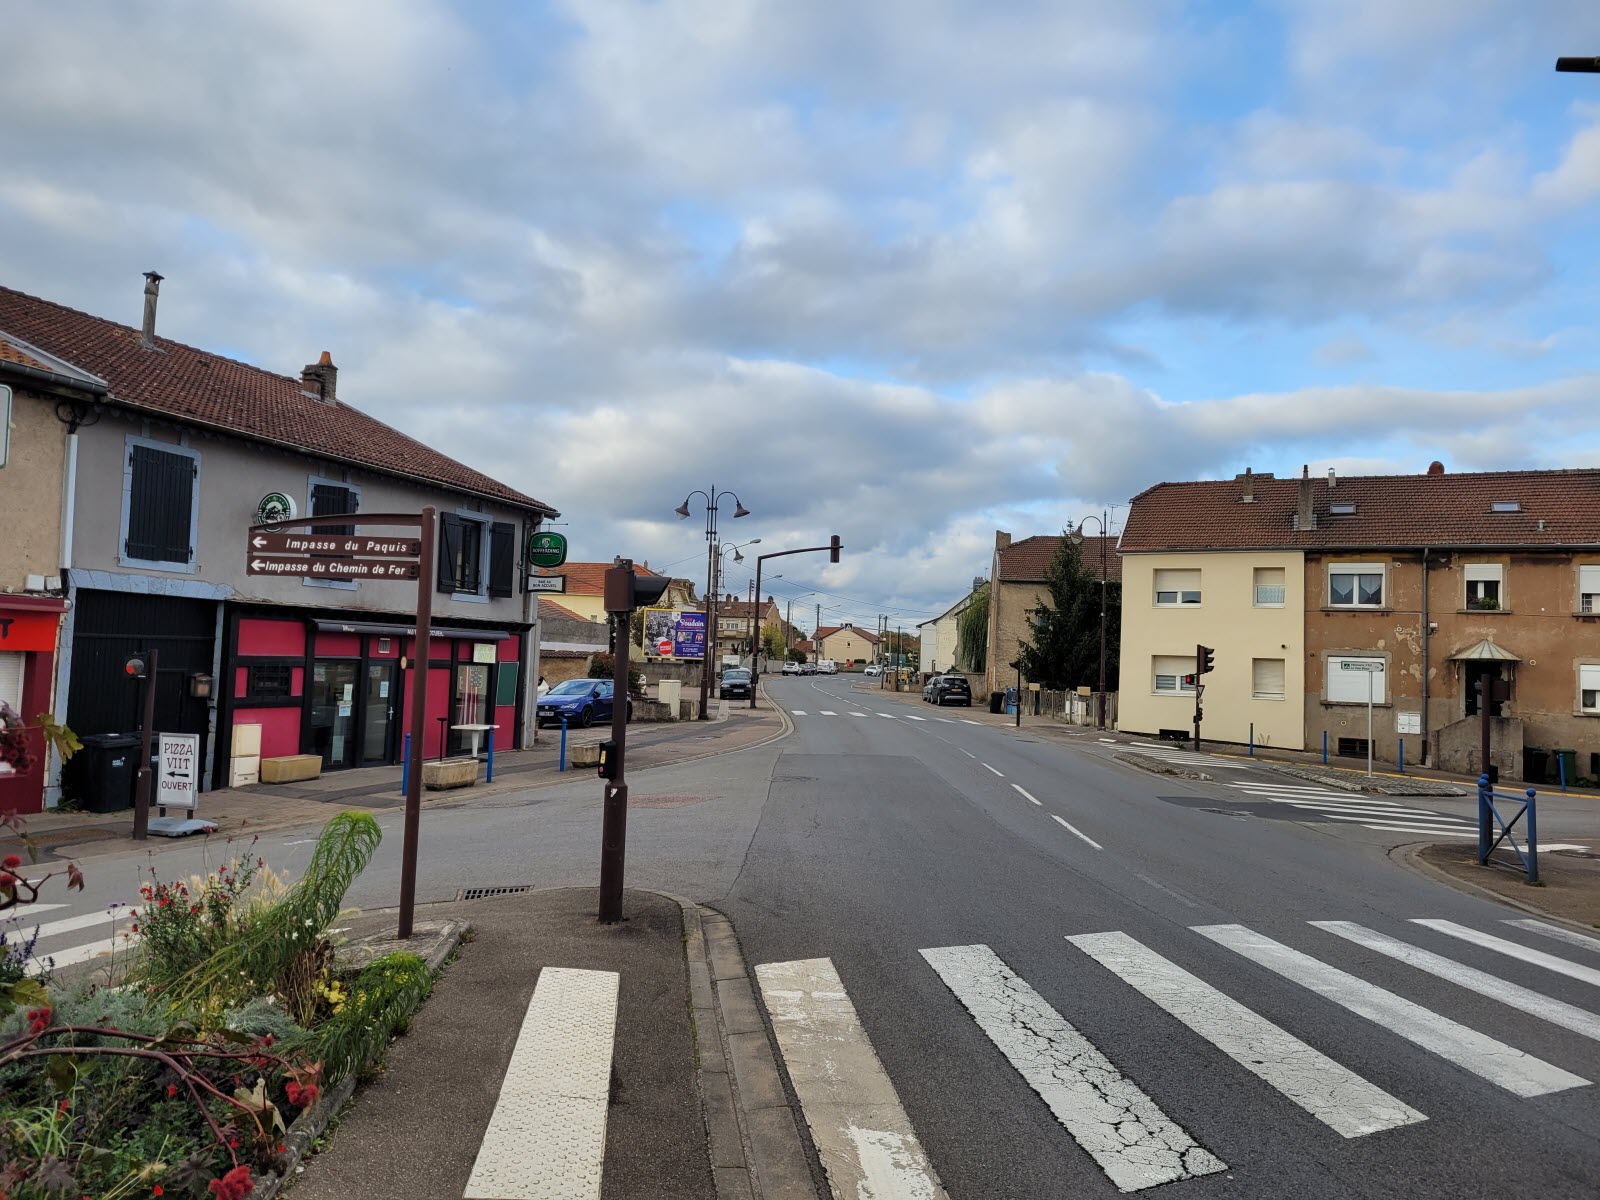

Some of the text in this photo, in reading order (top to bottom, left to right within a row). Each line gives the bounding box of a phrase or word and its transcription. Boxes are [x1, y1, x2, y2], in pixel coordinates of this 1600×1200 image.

[286, 538, 407, 554] Impasse du Paquis
[265, 561, 406, 575] Impasse du Chemin de Fer
[164, 742, 194, 756] PIZZA
[166, 758, 190, 770] VIIT
[161, 780, 193, 791] OUVERT
